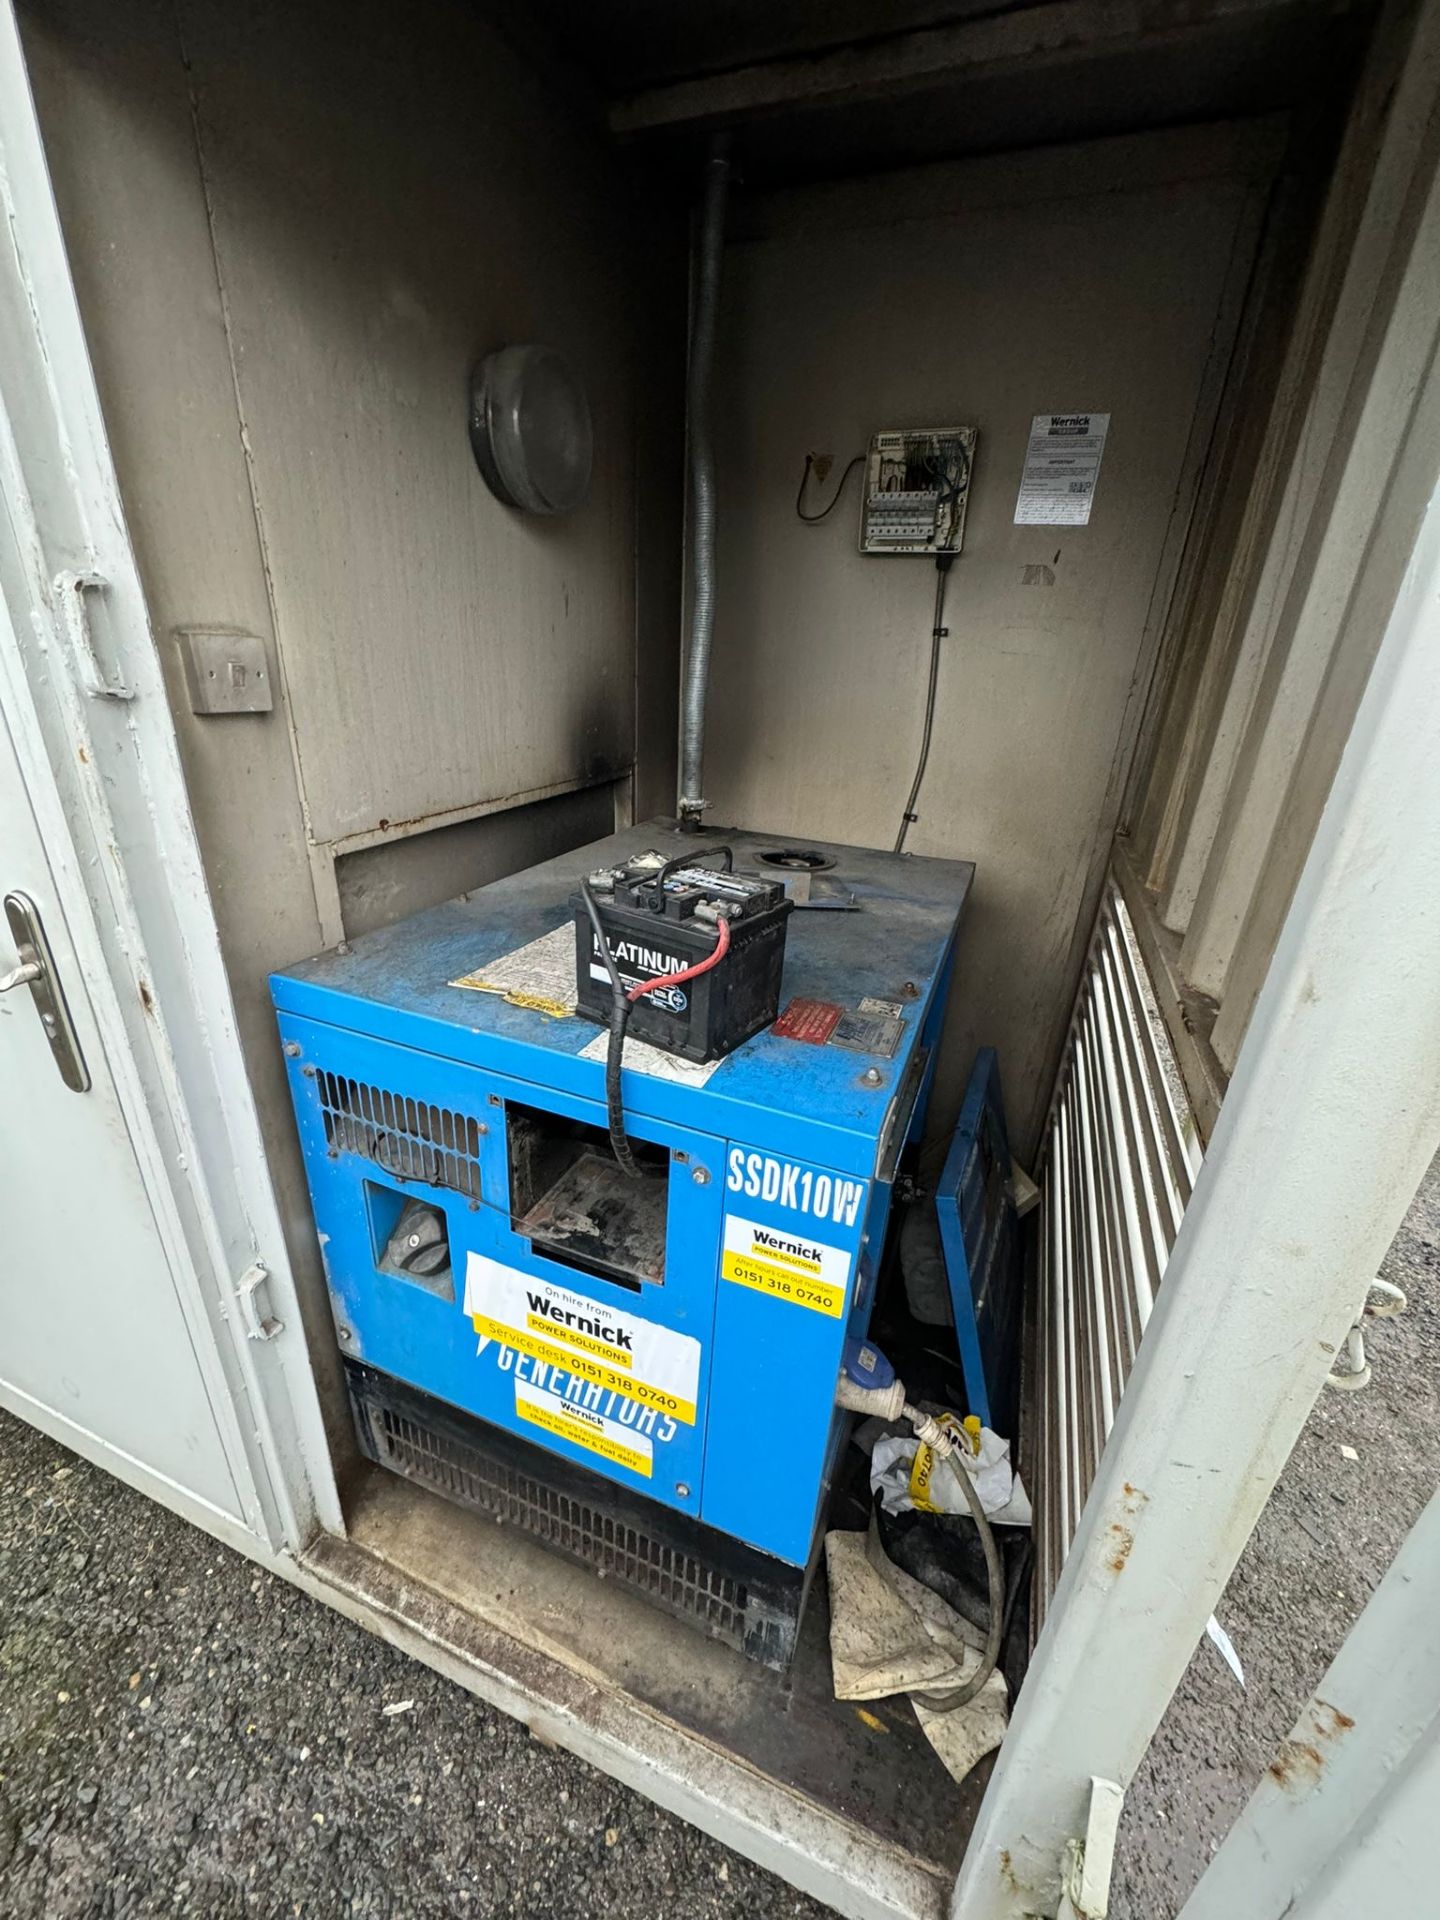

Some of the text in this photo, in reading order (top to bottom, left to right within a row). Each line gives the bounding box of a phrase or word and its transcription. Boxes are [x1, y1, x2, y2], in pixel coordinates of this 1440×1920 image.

[1051, 416, 1090, 427] Wernick
[728, 1148, 863, 1227] SSDK10W
[753, 1229, 822, 1262] Wernick
[754, 1246, 818, 1272] POWER SOLUTIONS
[734, 1267, 833, 1308] 0151 318 0740
[736, 1257, 754, 1267] After
[755, 1262, 775, 1276] hours
[791, 1275, 803, 1286] out
[805, 1280, 834, 1295] number
[526, 1291, 632, 1351] Wernick
[545, 1286, 613, 1319] On hire from
[531, 1319, 628, 1364] POWER SOLUTIONS
[489, 1322, 677, 1410] Service desk 0151 318 0740
[560, 1400, 605, 1427] Wernick
[530, 1413, 552, 1427] check
[567, 1430, 590, 1444] water
[599, 1444, 616, 1457] fuel
[617, 1453, 639, 1467] daily
